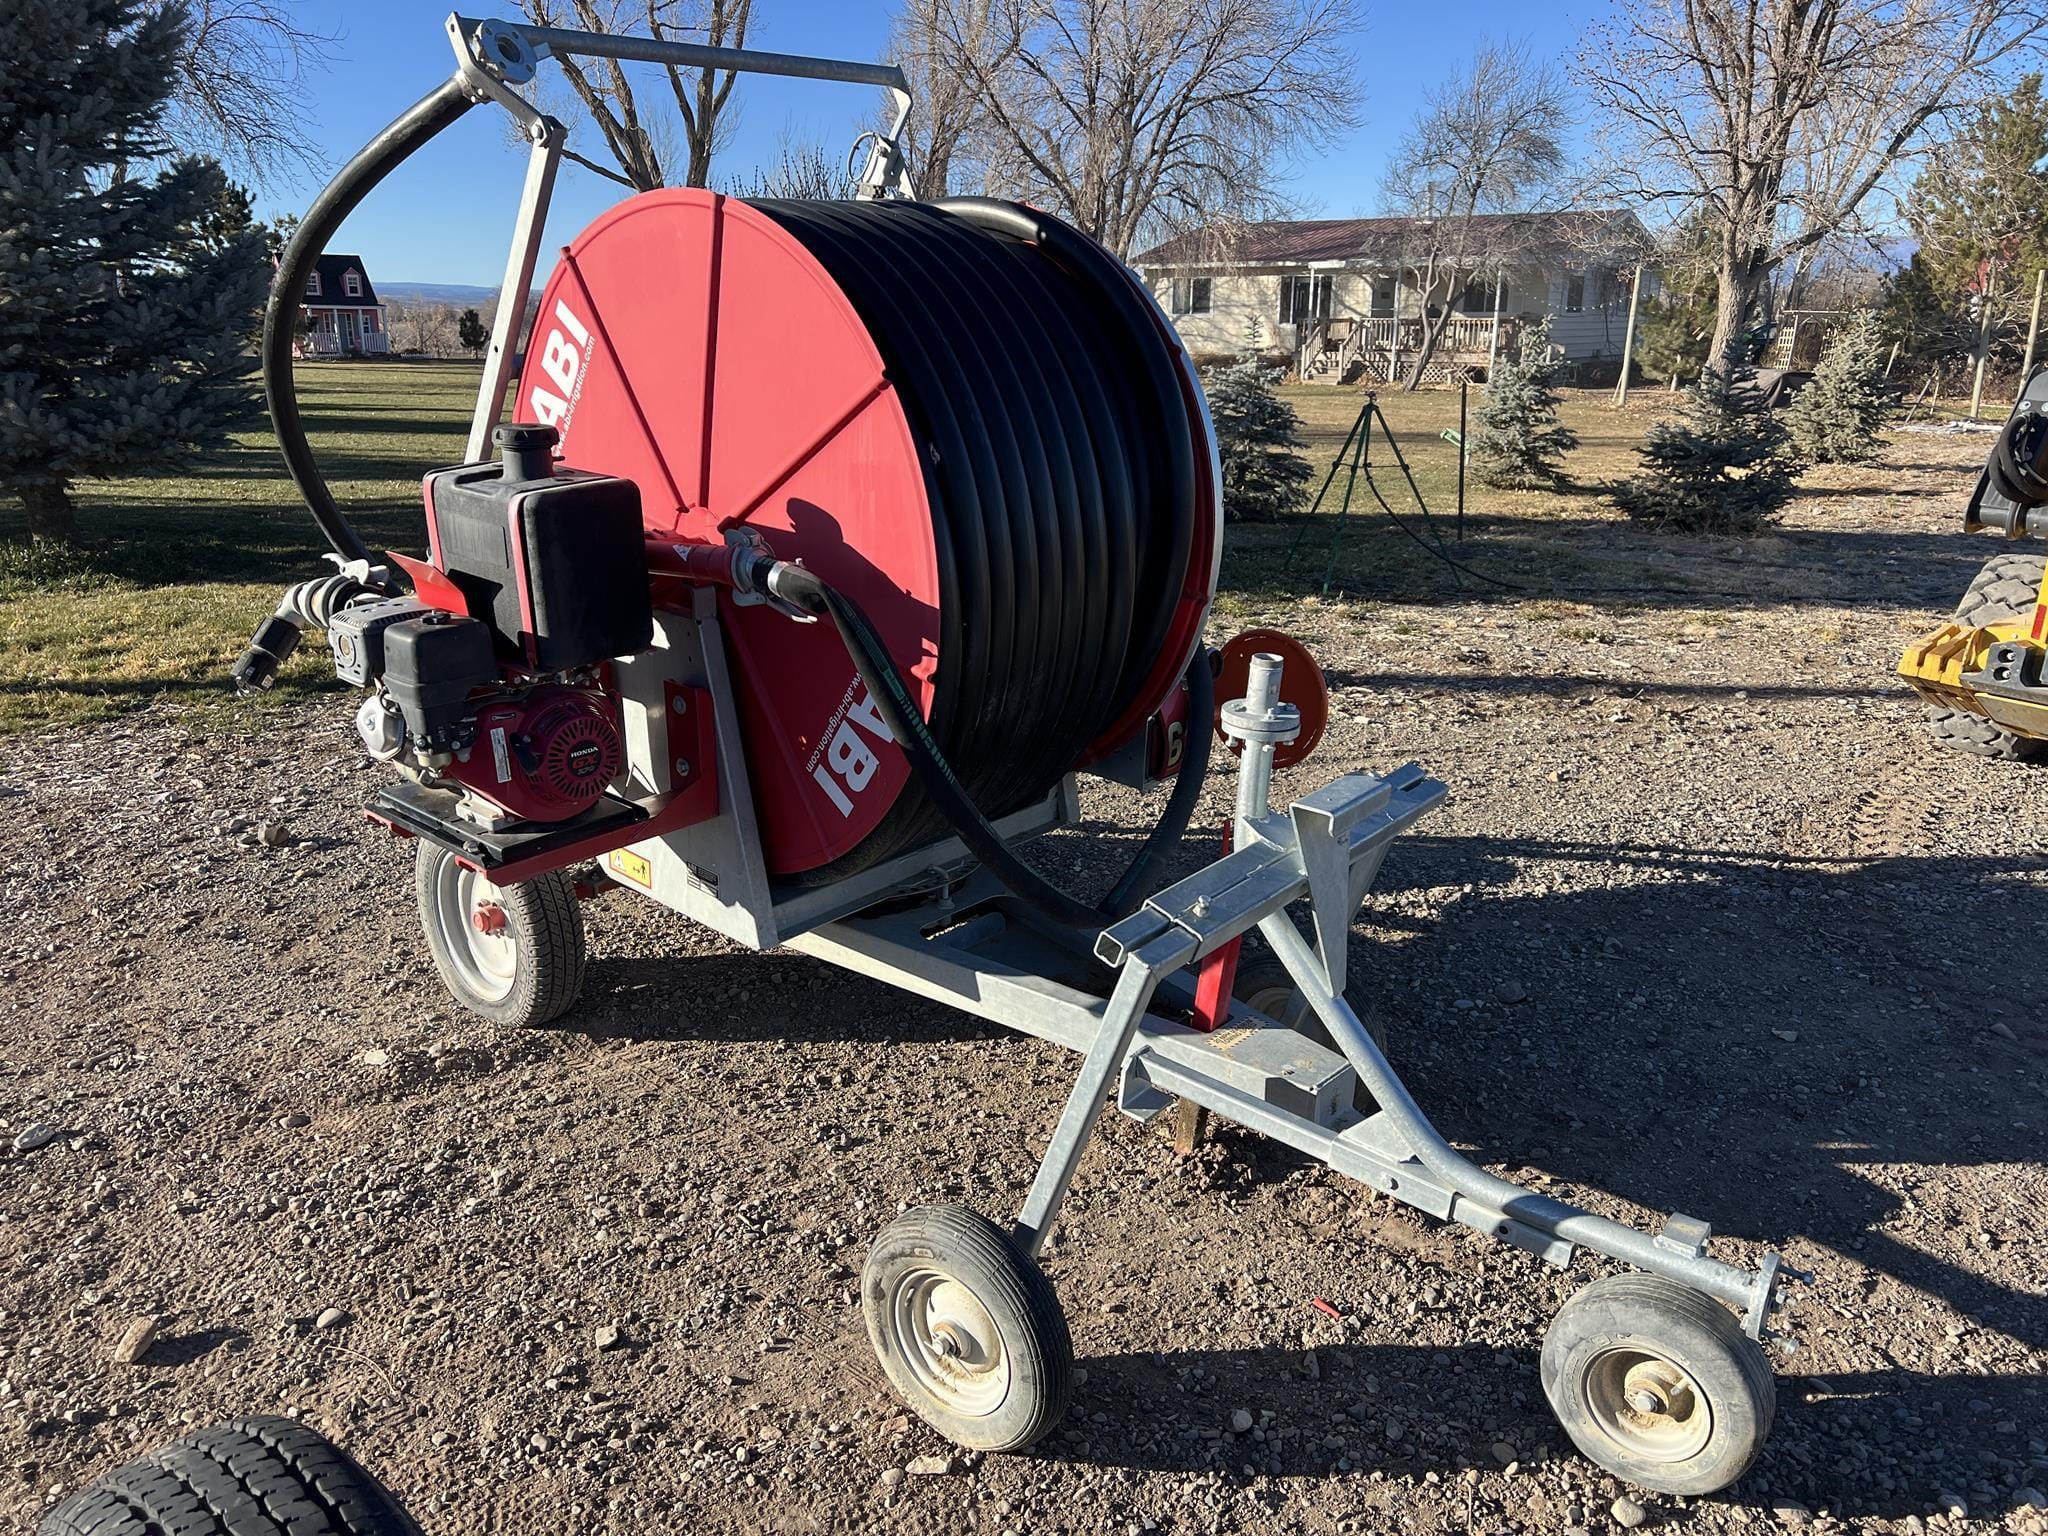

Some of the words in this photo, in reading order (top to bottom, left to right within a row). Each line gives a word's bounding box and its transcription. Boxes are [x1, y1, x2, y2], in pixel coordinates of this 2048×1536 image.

[530, 298, 589, 427] ABI
[570, 746, 599, 758] HONDA
[572, 754, 598, 769] GX
[813, 691, 894, 818] ABI
